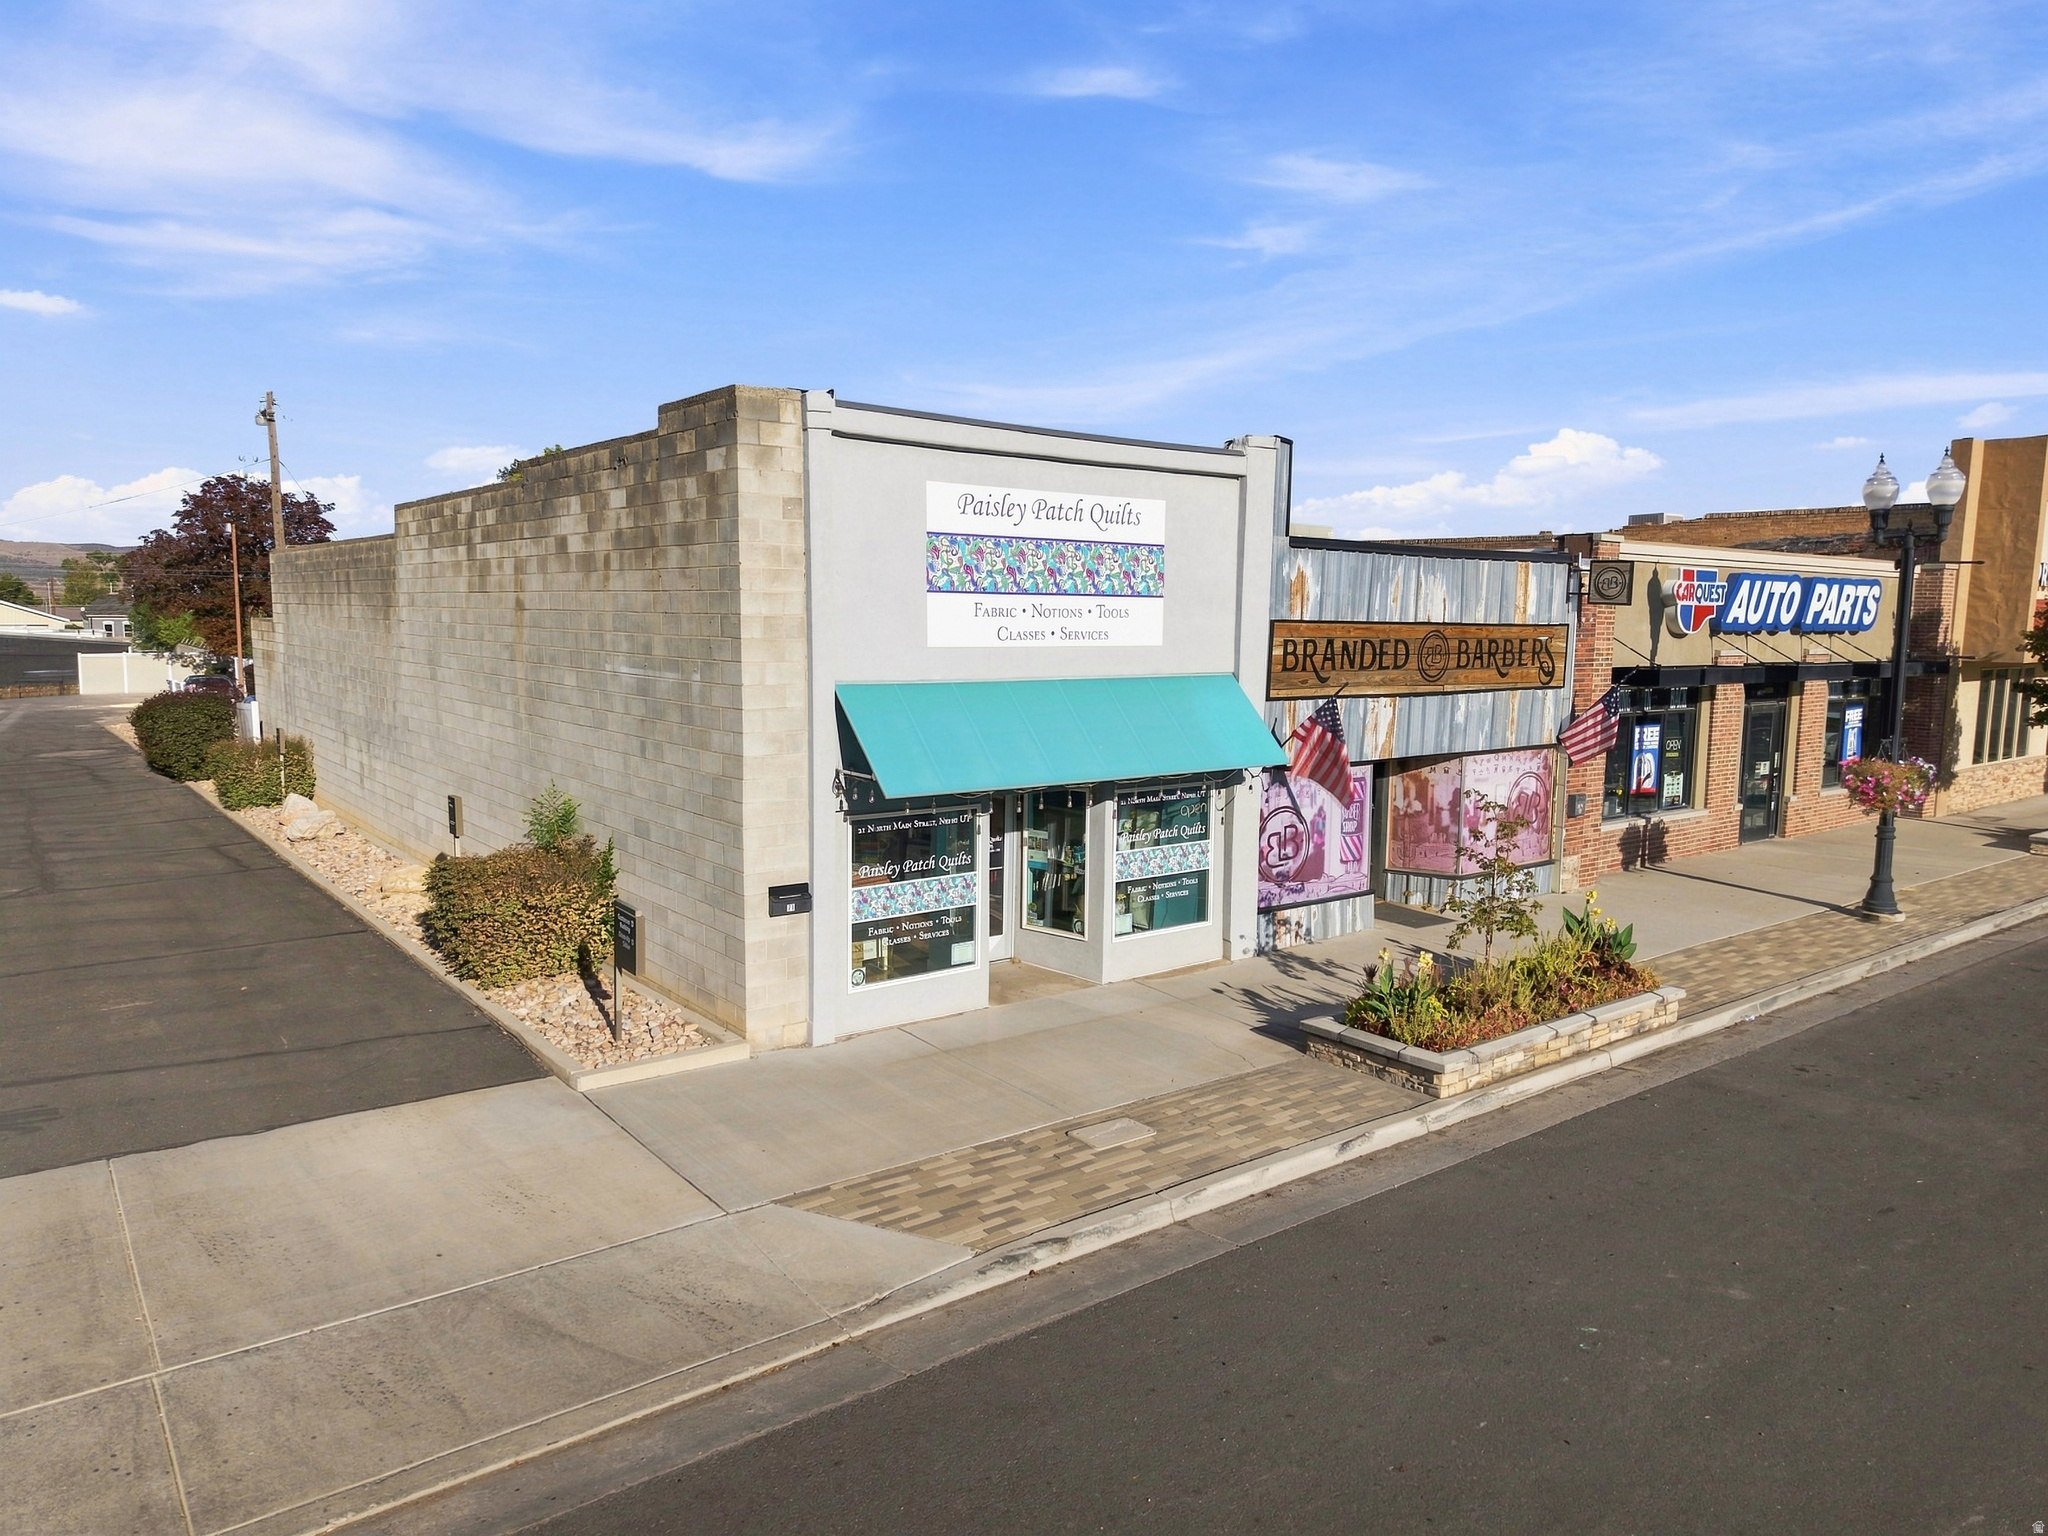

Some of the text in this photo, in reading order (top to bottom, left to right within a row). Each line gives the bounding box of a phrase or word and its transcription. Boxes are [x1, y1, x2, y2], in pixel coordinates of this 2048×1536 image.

[957, 493, 1142, 532] Paisley Patch Quilts
[1676, 582, 1727, 602] CARQUEST
[974, 602, 1130, 619] FABRIC NOTIONS TOOLS
[1726, 580, 1881, 625] AUTO PARTS
[997, 626, 1109, 641] CLASSES SERVICES
[1282, 638, 1411, 684] BRANDED
[1456, 636, 1556, 686] BARBERS
[1666, 739, 1682, 751] OPEN
[867, 823, 892, 833] NORTH
[893, 821, 912, 831] MAIN
[1120, 821, 1206, 844] Paisley Patch Quilts
[858, 851, 972, 879] Paisley Patch Quilts
[1182, 877, 1198, 886] TOOLS
[1165, 889, 1189, 899] SERVICES
[868, 915, 962, 937] FABRIC NOTIONS TOOLS
[881, 929, 950, 946] CLASSES SERVICES
